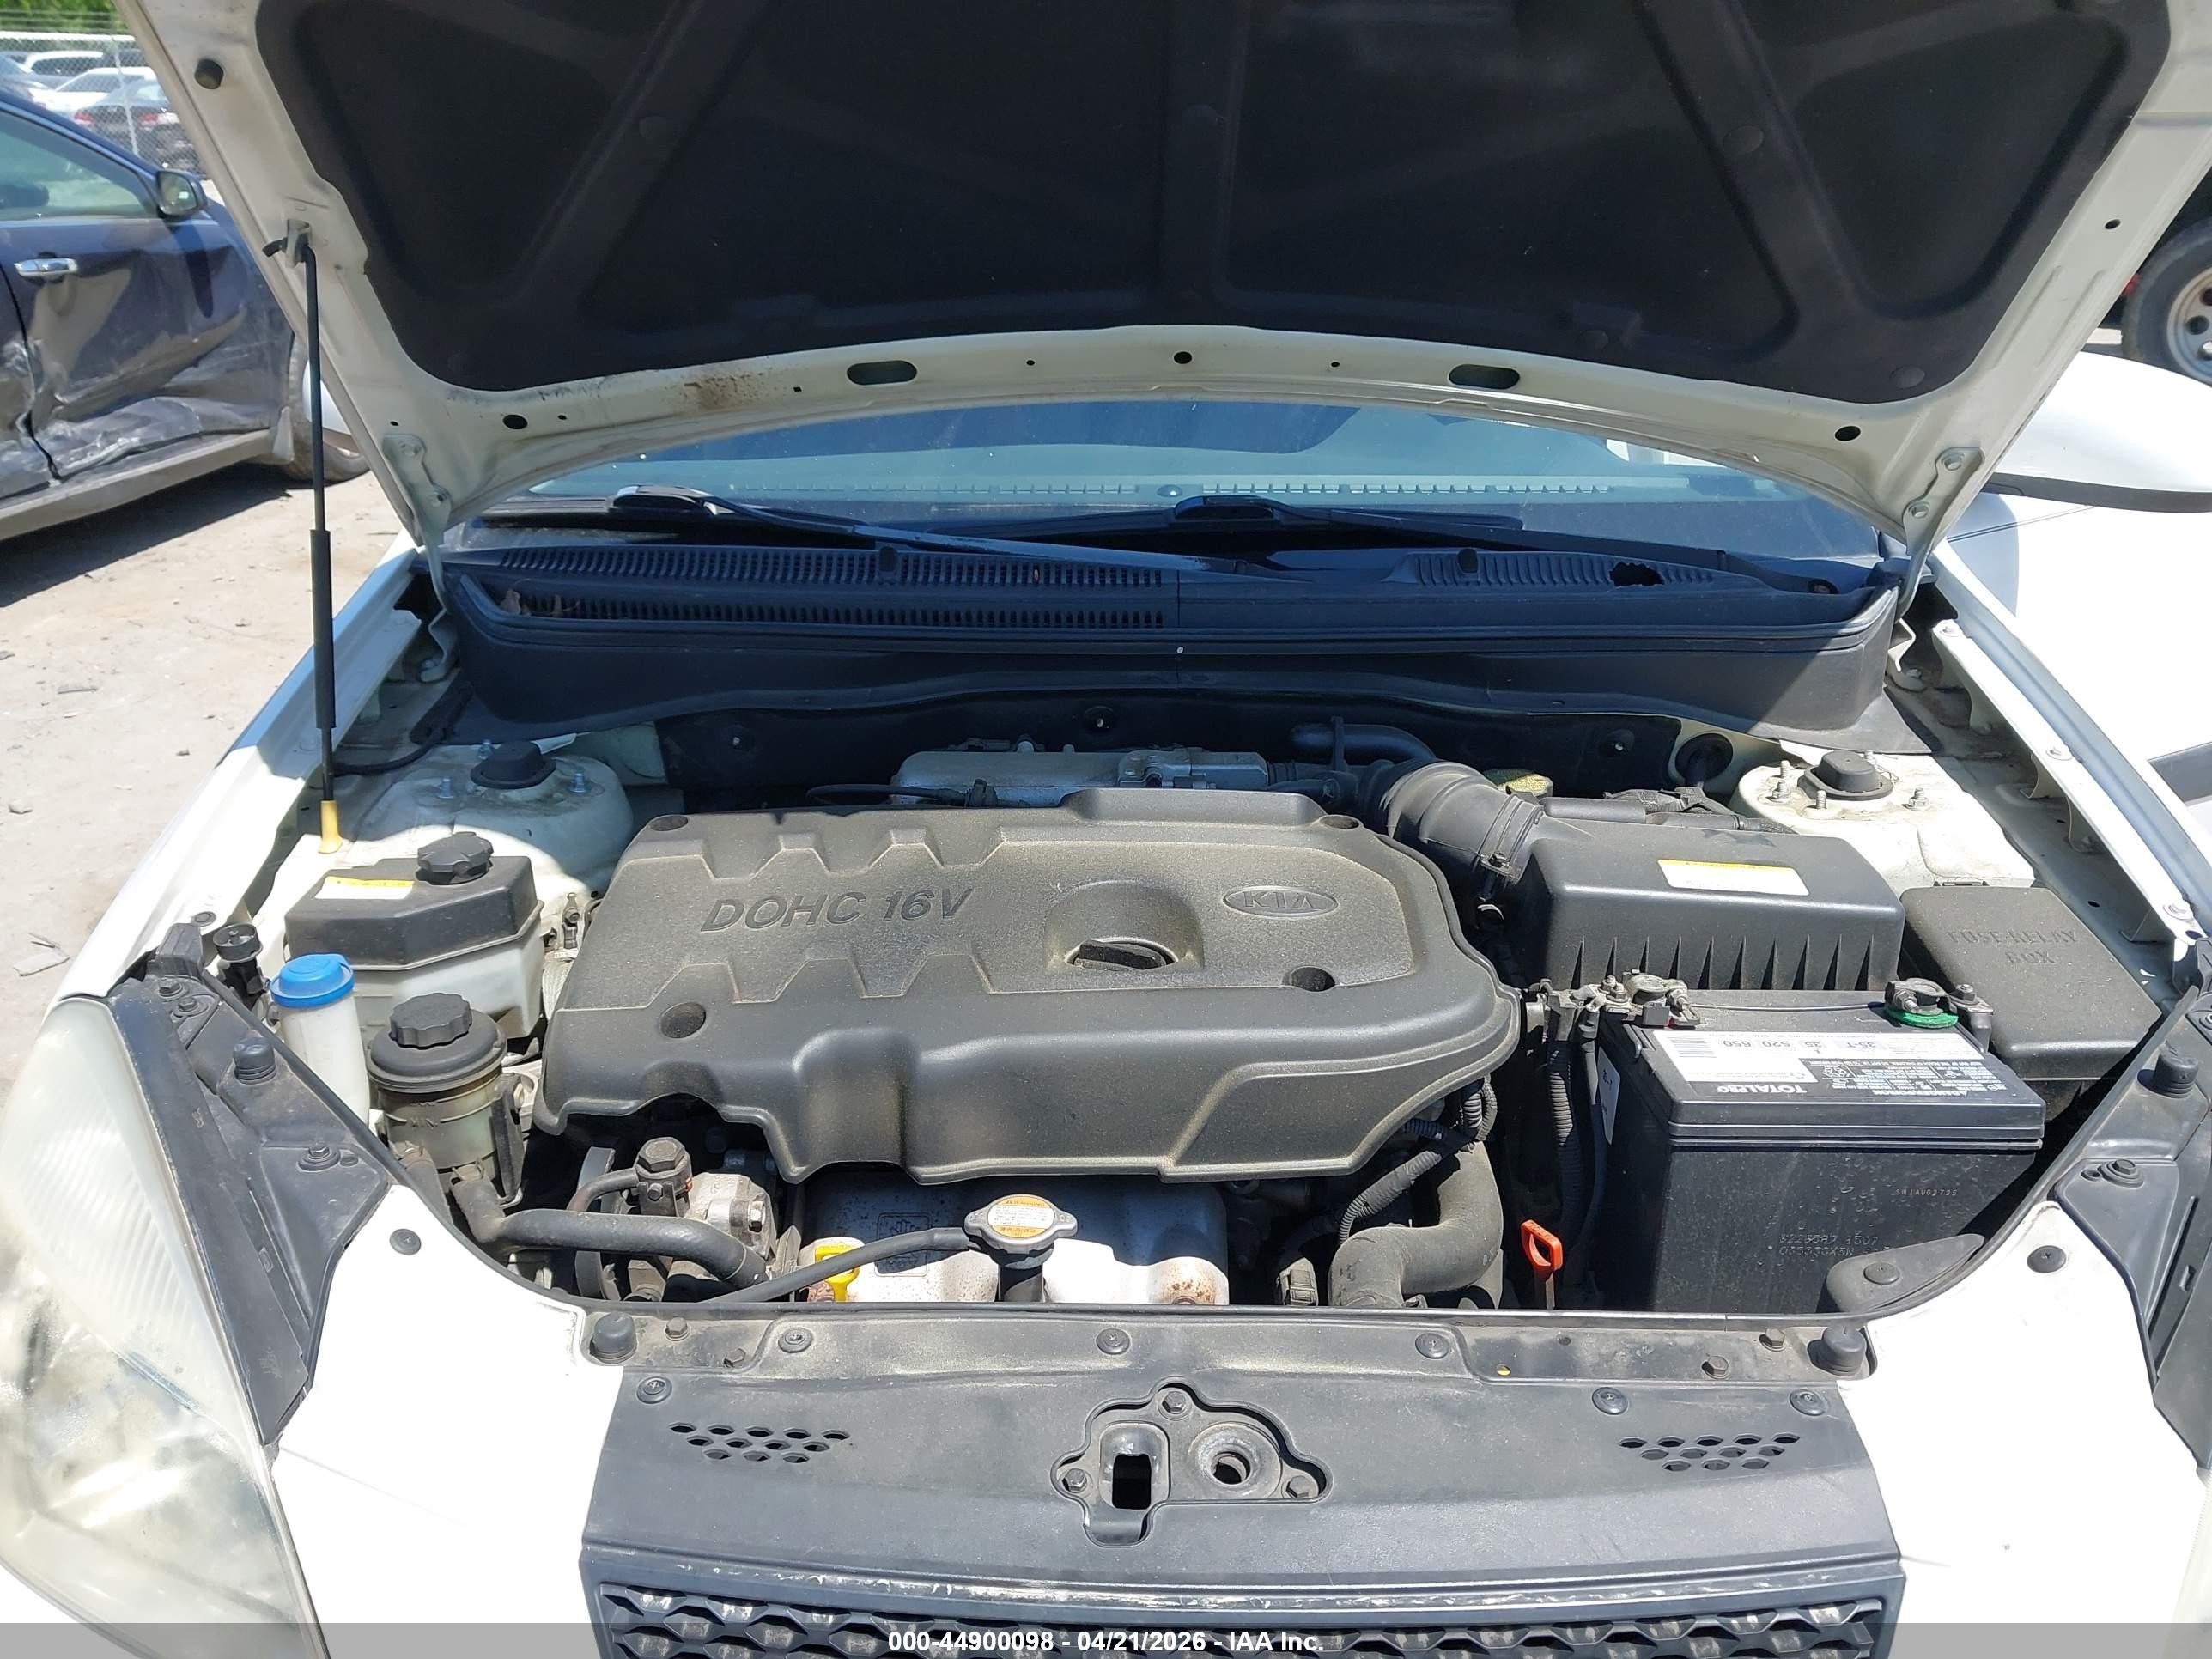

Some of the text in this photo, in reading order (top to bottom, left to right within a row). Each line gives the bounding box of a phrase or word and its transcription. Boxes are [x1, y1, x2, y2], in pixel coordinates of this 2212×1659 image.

[1244, 891, 1319, 909] KIA
[700, 888, 973, 933] DOHC 16V
[1723, 1039, 1752, 1048] 650
[1717, 1085, 1808, 1094] TOTALPRO
